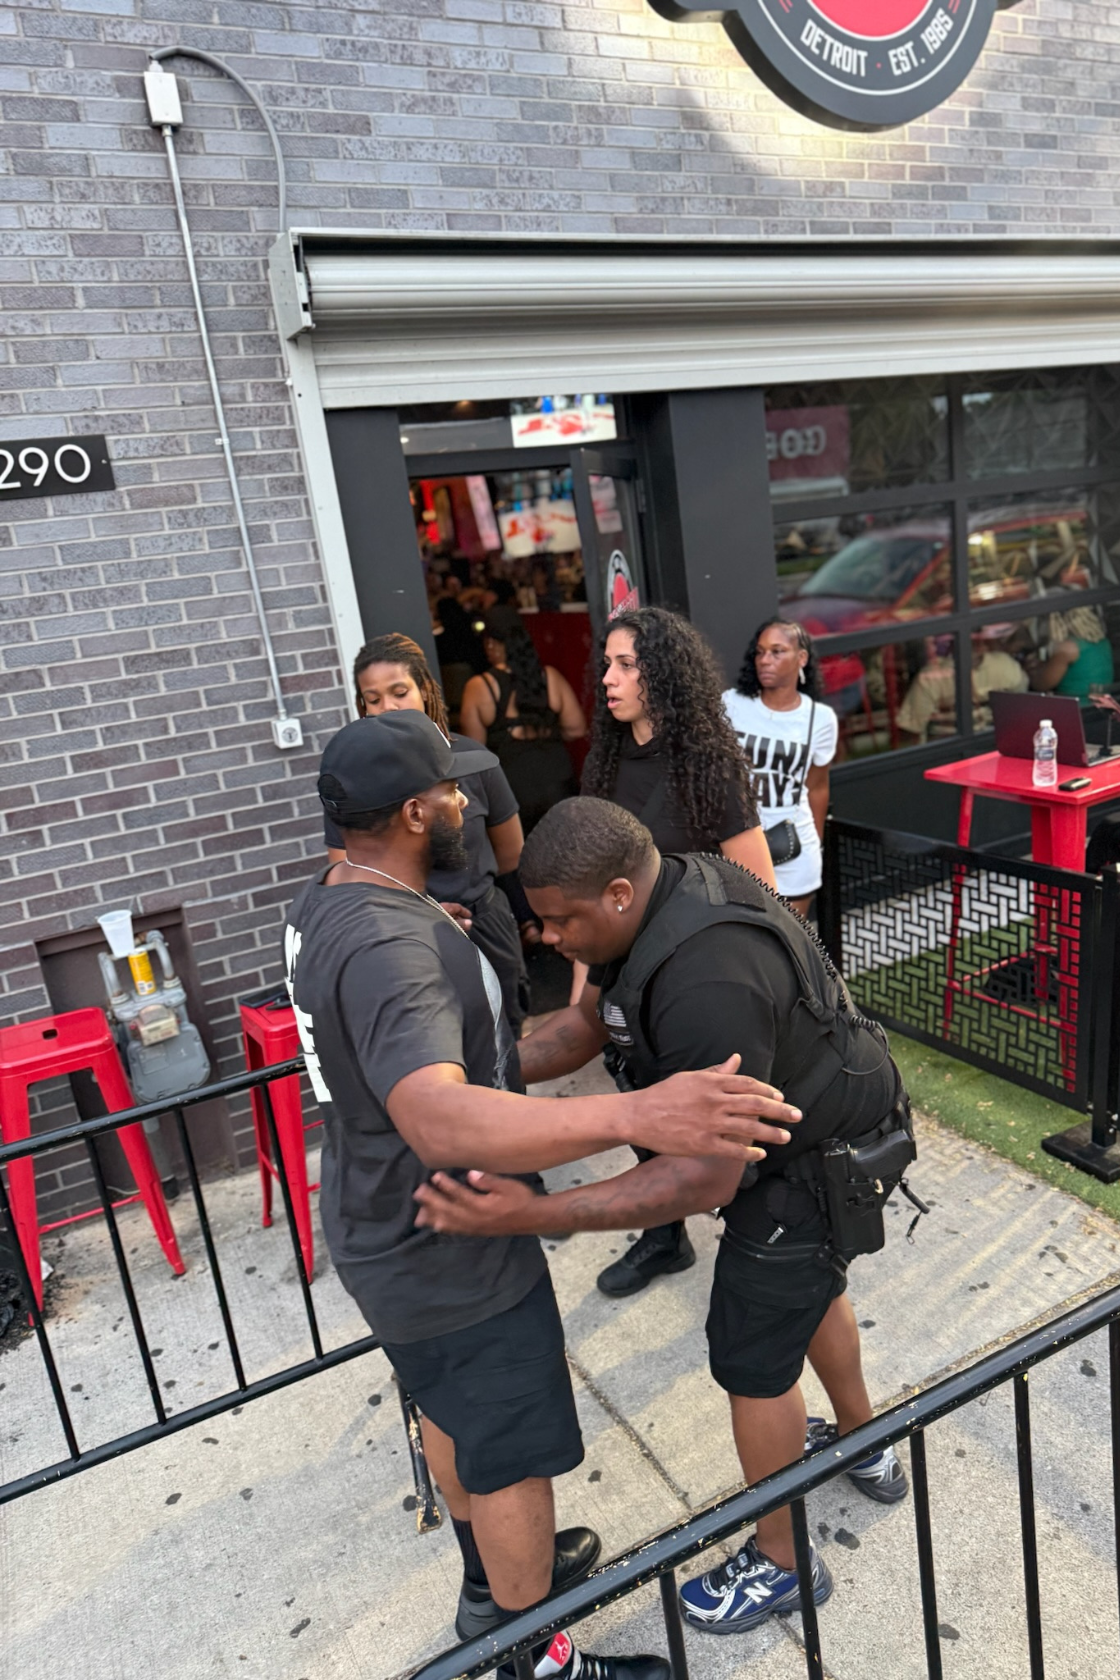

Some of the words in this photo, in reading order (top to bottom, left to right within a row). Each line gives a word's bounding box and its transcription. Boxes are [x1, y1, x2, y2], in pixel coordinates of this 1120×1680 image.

[800, 18, 868, 77] DETROIT
[888, 41, 926, 76] EST.
[919, 7, 954, 55] 1985
[0, 444, 91, 490] 290
[744, 1582, 773, 1604] N
